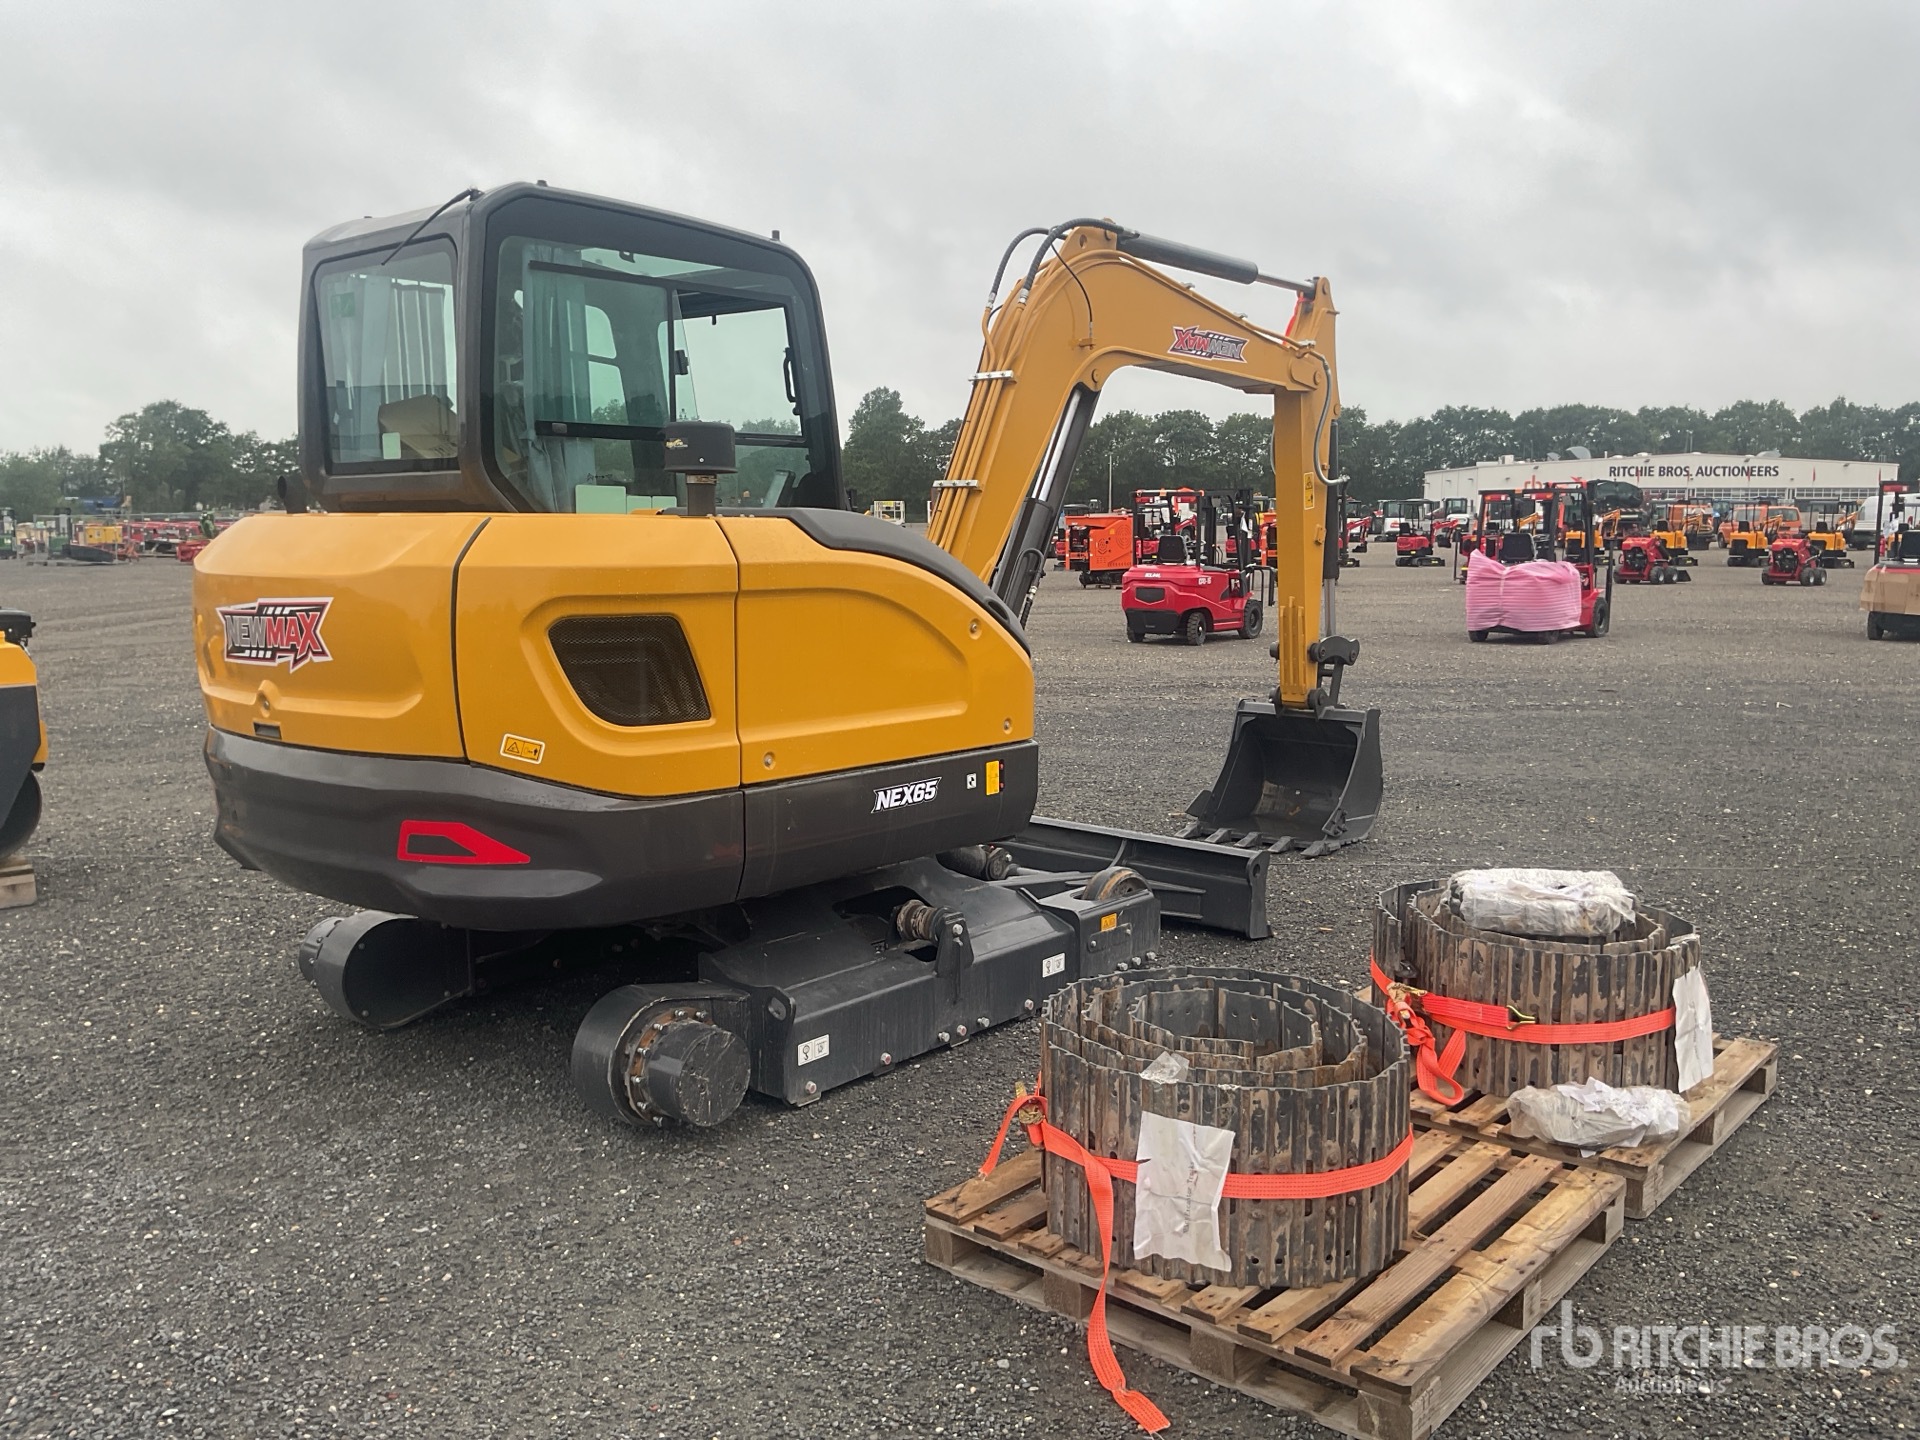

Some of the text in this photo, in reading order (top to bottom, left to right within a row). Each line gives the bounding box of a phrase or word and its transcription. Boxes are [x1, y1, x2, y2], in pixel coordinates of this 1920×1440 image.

[1174, 330, 1243, 359] NEWMAX
[1609, 465, 1779, 477] RITCHIE BROS. AUCTIONEERS
[224, 611, 323, 660] NEWMAX
[875, 779, 938, 811] NEX65
